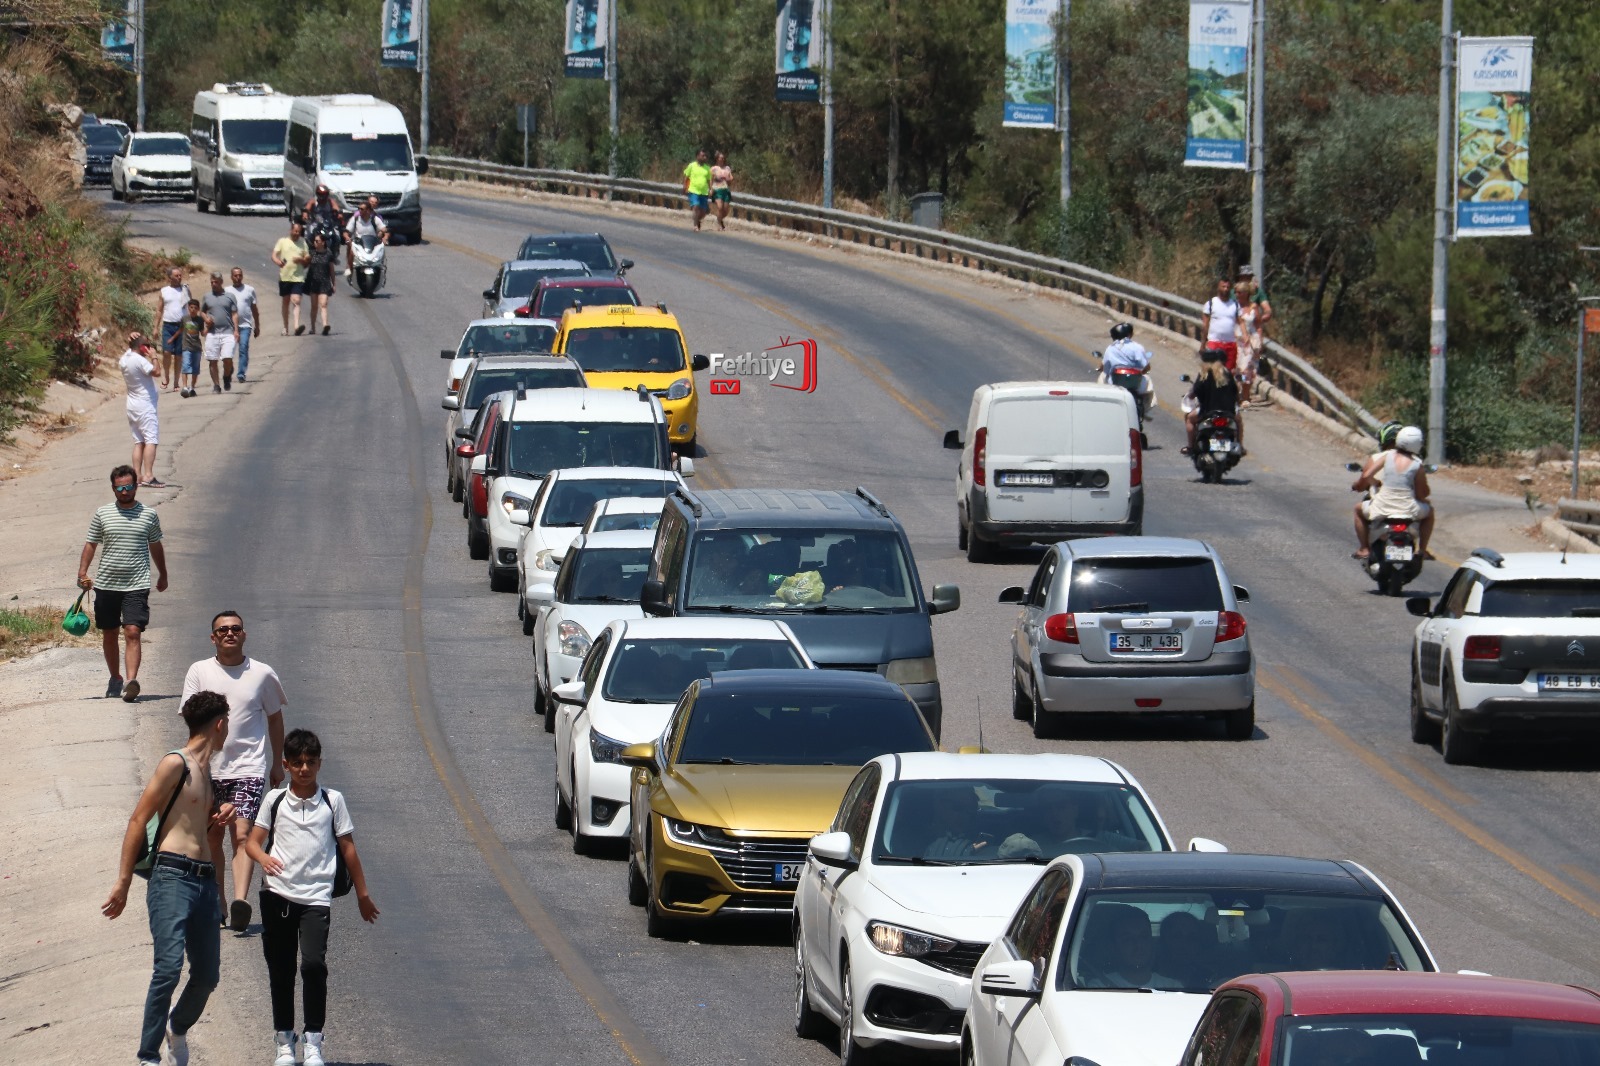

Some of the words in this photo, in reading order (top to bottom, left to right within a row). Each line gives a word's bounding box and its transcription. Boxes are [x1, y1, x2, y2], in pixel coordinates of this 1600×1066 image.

[786, 19, 797, 51] BLADE
[1118, 636, 1131, 647] 35
[1139, 636, 1153, 647] JR
[1159, 636, 1179, 647] 438
[1545, 676, 1559, 687] 48
[1567, 676, 1582, 687] EB
[782, 865, 800, 880] 34
